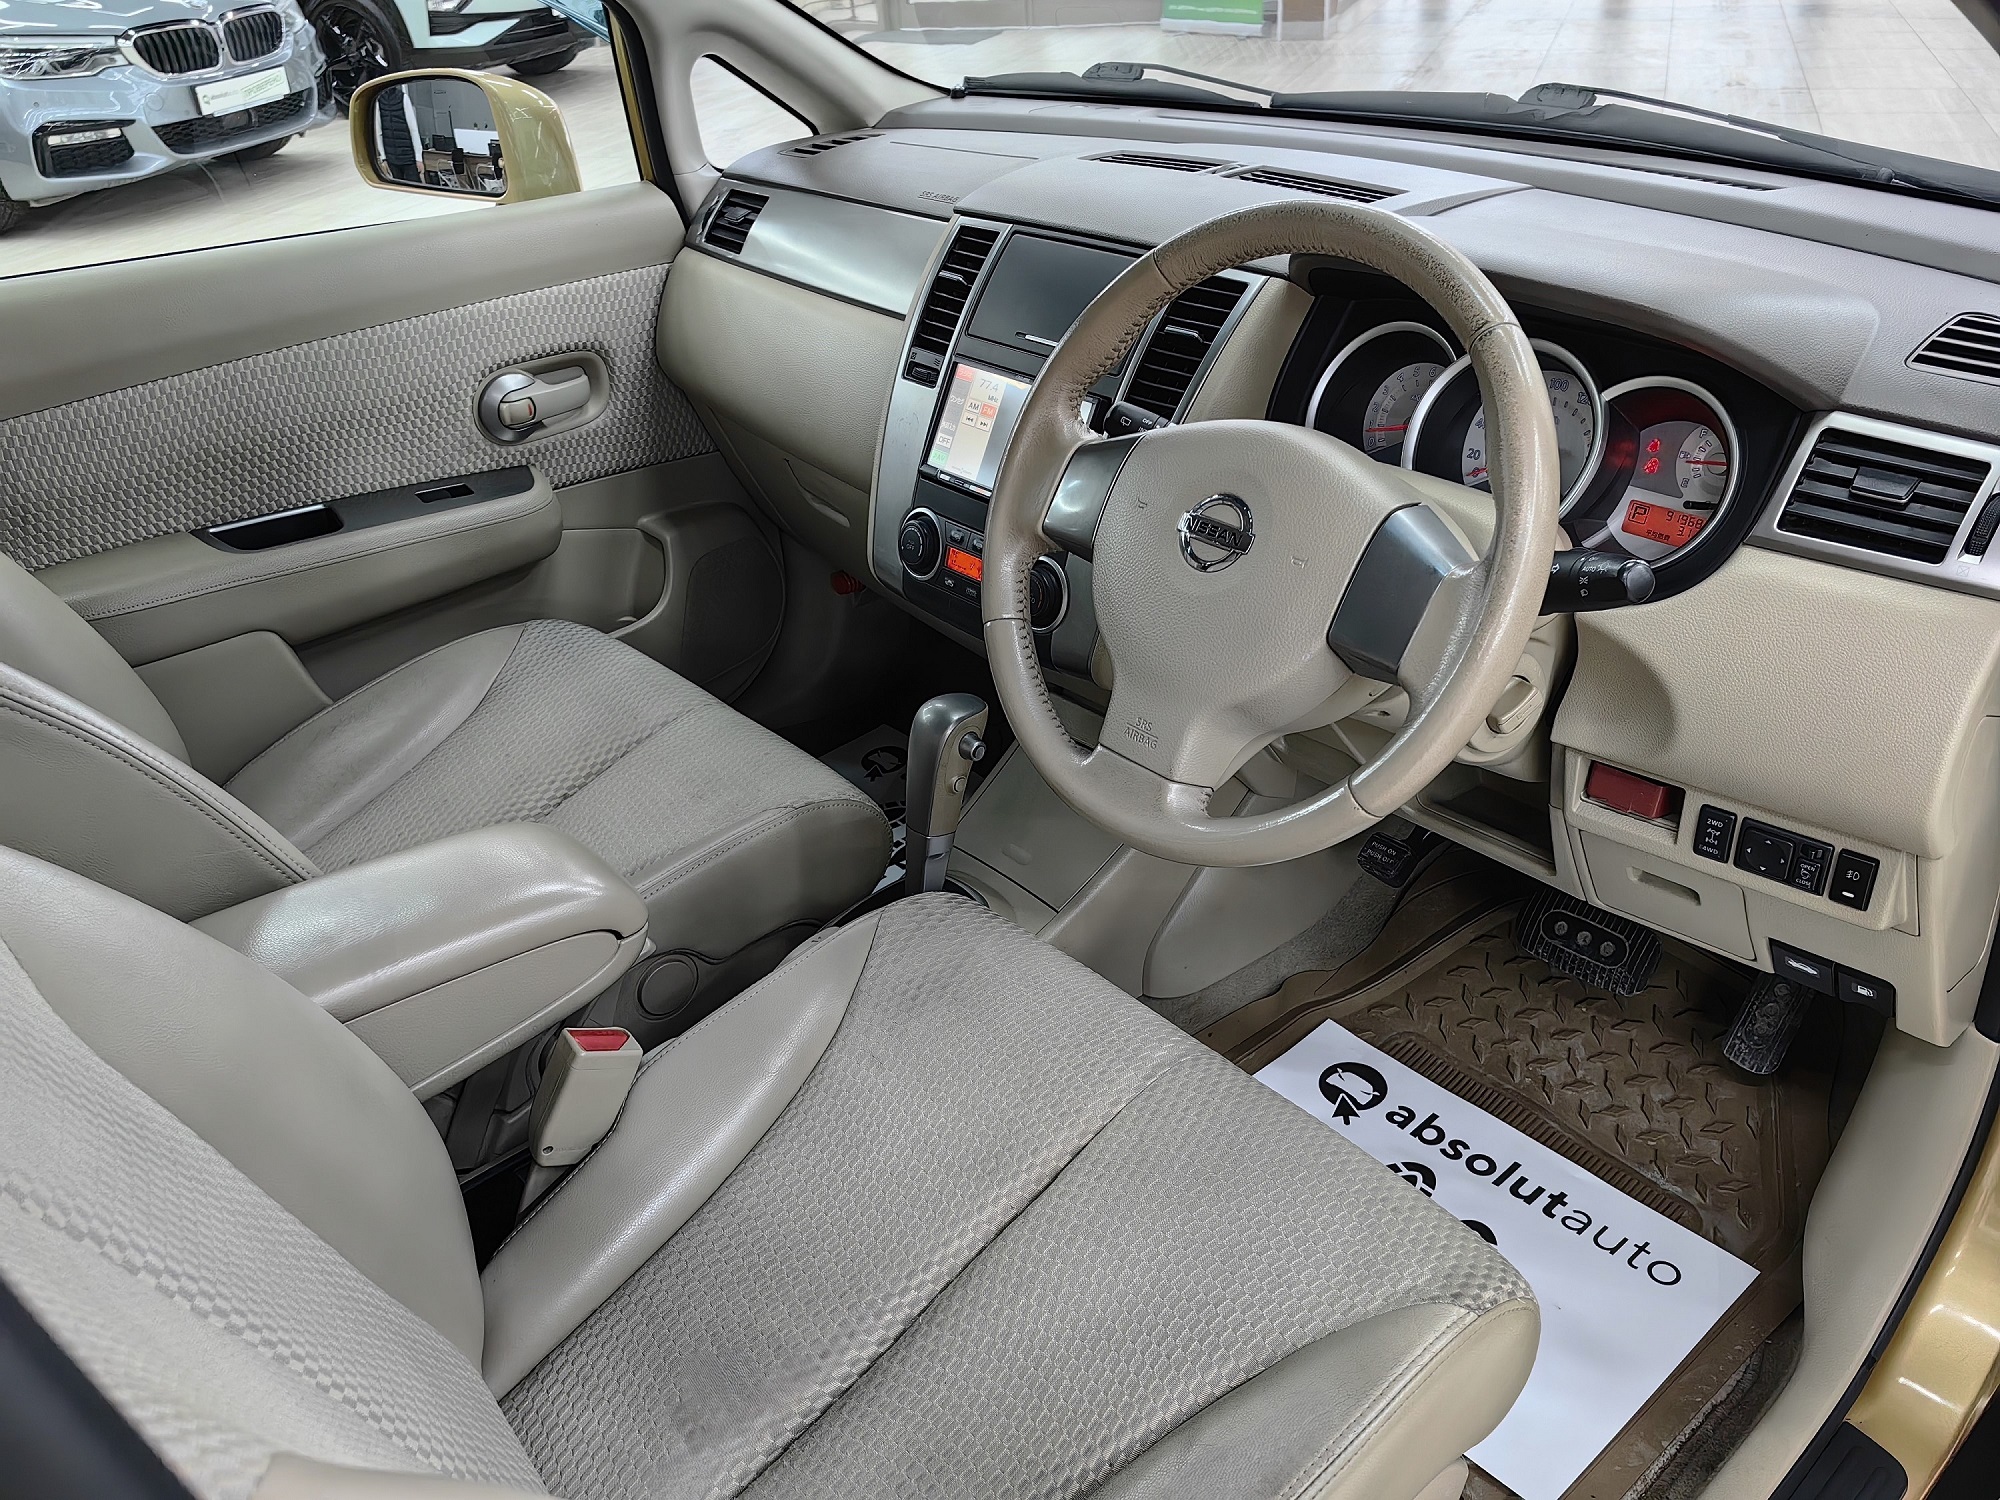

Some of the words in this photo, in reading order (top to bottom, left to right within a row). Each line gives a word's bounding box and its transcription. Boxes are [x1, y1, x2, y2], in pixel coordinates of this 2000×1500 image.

[1396, 372, 1404, 383] 4
[1412, 365, 1421, 377] 5
[1428, 366, 1437, 377] 6
[979, 378, 999, 393] 77.4
[1382, 385, 1390, 395] 3
[1549, 378, 1570, 392] 100
[1576, 391, 1591, 406] 12
[967, 401, 980, 411] AM
[982, 405, 994, 416] FM
[1371, 401, 1379, 413] 2
[1699, 428, 1708, 438] F
[938, 435, 951, 445] OFF
[1367, 437, 1375, 447] 0
[1466, 447, 1481, 460] 20
[1680, 477, 1690, 488] E
[1665, 510, 1704, 528] 91968
[1184, 516, 1244, 548] NISSAN
[1135, 716, 1153, 732] SRS
[1123, 726, 1159, 750] AIRBAG
[1706, 818, 1724, 828] 2WD
[1371, 841, 1388, 852] PUSH
[1387, 848, 1397, 856] ON
[1366, 849, 1382, 860] PUSH
[1382, 855, 1395, 864] OFF
[1799, 863, 1816, 872] OPEN
[1384, 1104, 1682, 1286] absolutauto
